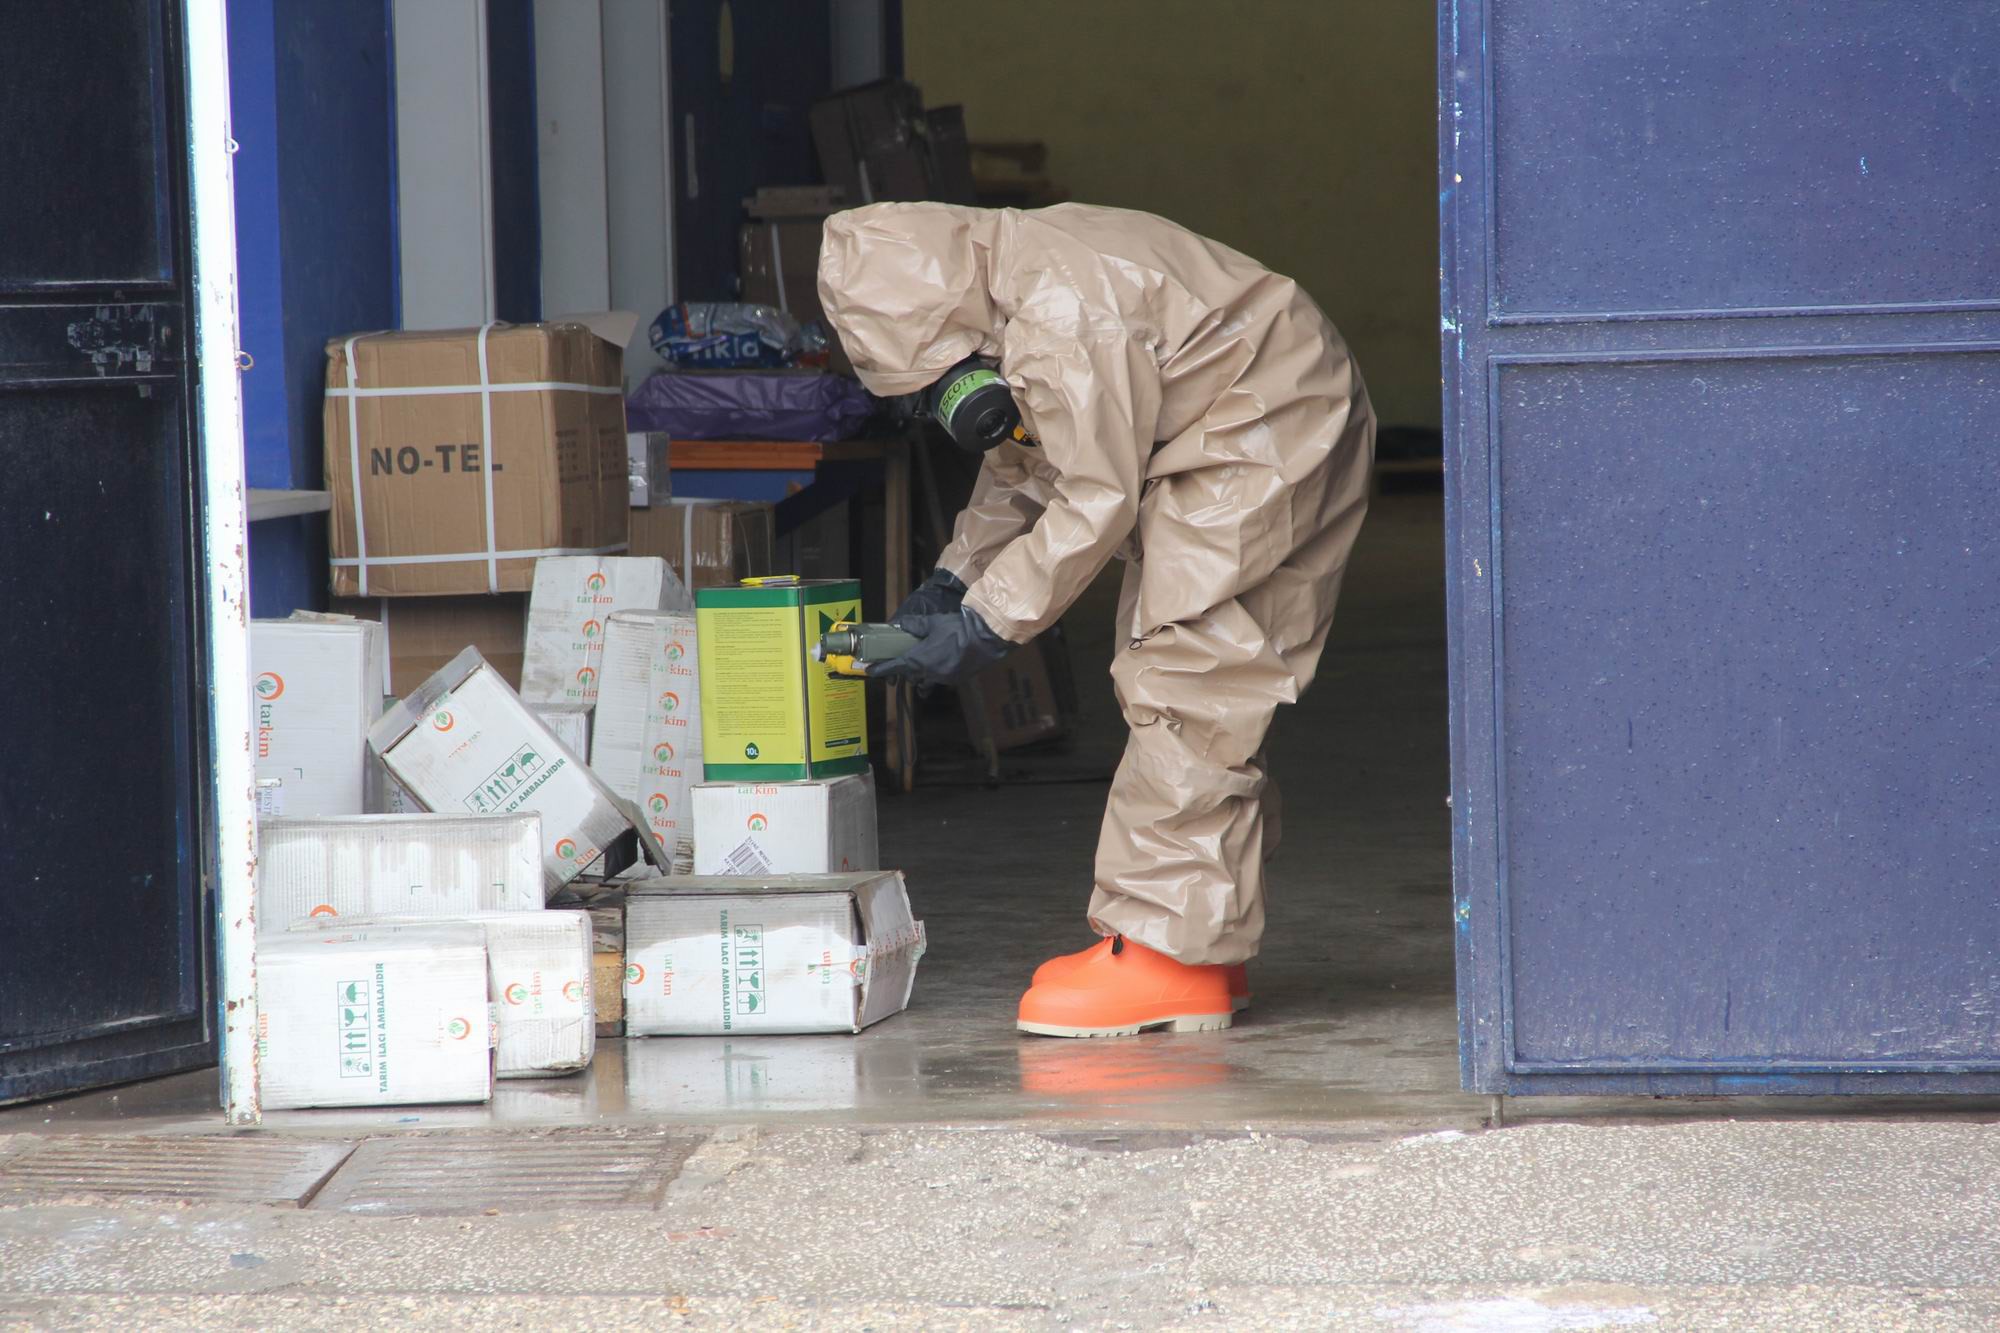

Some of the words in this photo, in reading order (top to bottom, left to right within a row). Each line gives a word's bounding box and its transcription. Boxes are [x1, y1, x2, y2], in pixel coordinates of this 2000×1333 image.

[942, 372, 976, 409] SCOTT
[576, 594, 613, 604] tarkim
[258, 703, 274, 758] tarkim
[518, 758, 566, 803] AMBALAJIDIR
[720, 909, 728, 939] TARIM
[375, 963, 386, 1030] AMBALAJIDIR
[721, 968, 732, 1031] AMBALAJIDIR
[379, 1061, 388, 1093] TARIM
